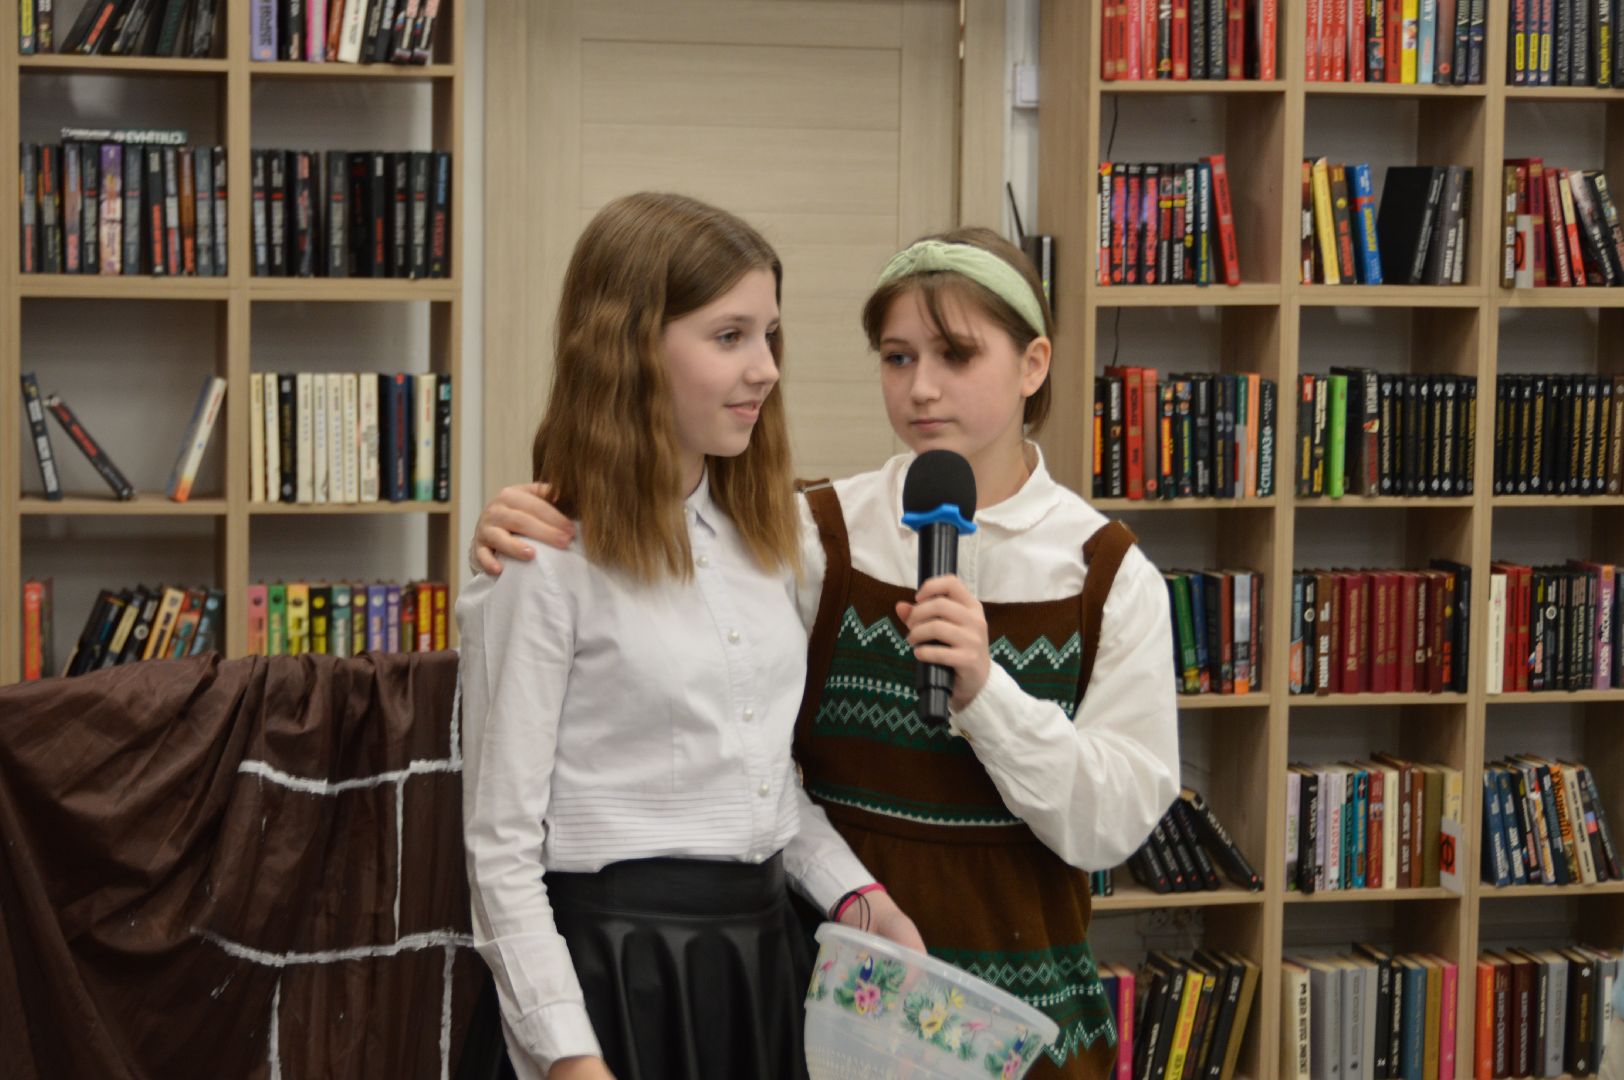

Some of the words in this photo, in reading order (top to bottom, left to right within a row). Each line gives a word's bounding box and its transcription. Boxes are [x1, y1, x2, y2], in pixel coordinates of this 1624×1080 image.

[1260, 437, 1273, 489] СПЕЦНАЗ
[1600, 587, 1611, 644] РАССКАЖЕТ
[1599, 645, 1609, 678] КРОВЬ
[1329, 807, 1341, 868] КРАСОТКА
